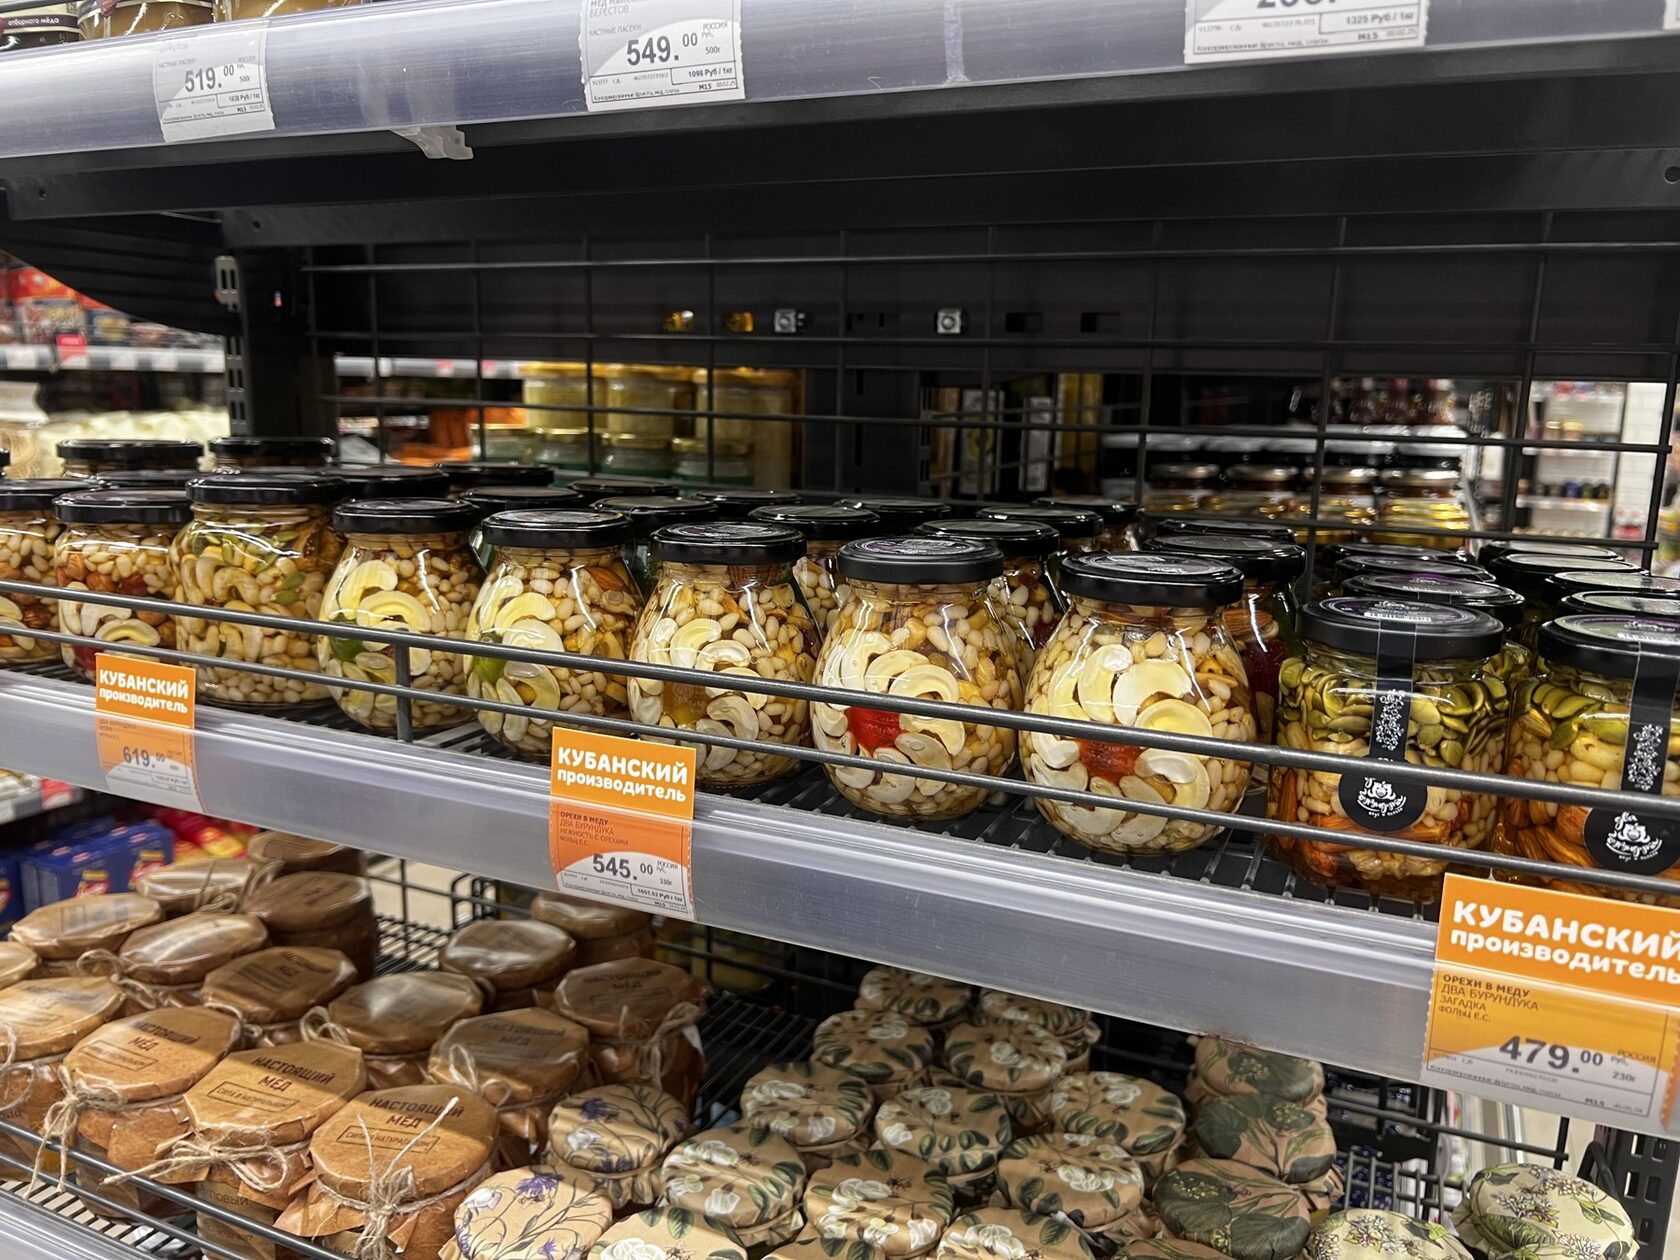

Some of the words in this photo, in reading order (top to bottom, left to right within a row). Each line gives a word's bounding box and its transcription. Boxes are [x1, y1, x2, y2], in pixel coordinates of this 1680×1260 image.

[589, 5, 629, 18] БЕРЕСТОВ
[703, 21, 728, 31] РОССИЯ
[626, 36, 680, 67] 549.
[682, 32, 698, 48] 00
[705, 46, 721, 56] 500г
[184, 67, 223, 93] 519.
[223, 64, 235, 77] 00
[99, 669, 189, 699] КУБАНСКИЙ
[99, 688, 188, 714] производитель
[122, 745, 155, 769] 619.
[557, 747, 688, 785] КУБАНСКИЙ
[557, 769, 687, 802] производитель
[560, 811, 582, 820] ОРЕХИ
[589, 816, 609, 826] МЕДУ
[560, 818, 574, 828] ДВА
[575, 822, 615, 836] БУРУНДУКА
[560, 828, 594, 840] НЕЖНОСТЬ
[594, 833, 600, 841] С
[600, 835, 629, 846] ОРЕХАМИ
[592, 853, 638, 881] 545.
[640, 862, 654, 875] 00
[1452, 900, 1680, 960] КУБАНСКИЙ
[1450, 929, 1680, 985] производитель
[1441, 983, 1466, 997] ДВА
[1469, 988, 1539, 1011] БУРУНДУКА
[1443, 974, 1482, 989] ОРЕХИ
[1485, 982, 1493, 991] В
[1496, 984, 1530, 998] МЕДУ
[1438, 1005, 1471, 1019] ФОЛЬЦ
[1473, 1011, 1492, 1023] Е.С.
[1440, 994, 1487, 1012] ЗАГАДКА
[1498, 1035, 1580, 1074] 479.
[1580, 1050, 1604, 1067] 00
[250, 1056, 336, 1085] НАСТОЯЩИЙ
[1612, 1071, 1636, 1083] 230г
